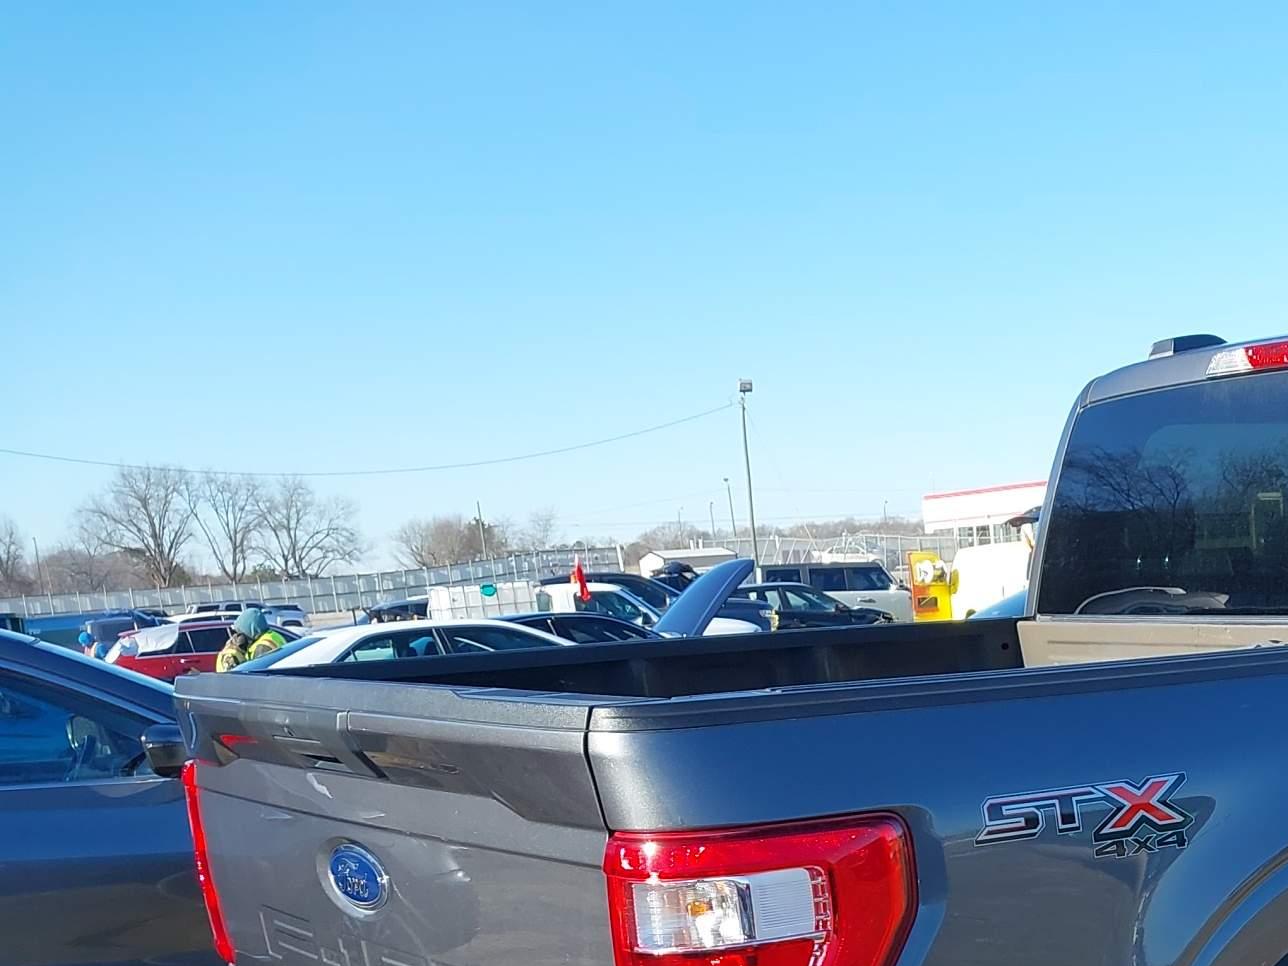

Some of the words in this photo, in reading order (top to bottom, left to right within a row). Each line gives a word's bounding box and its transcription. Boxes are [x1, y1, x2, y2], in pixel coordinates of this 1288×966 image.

[974, 771, 1195, 847] STX
[1093, 830, 1188, 858] 4x4
[337, 857, 369, 898] Ford
